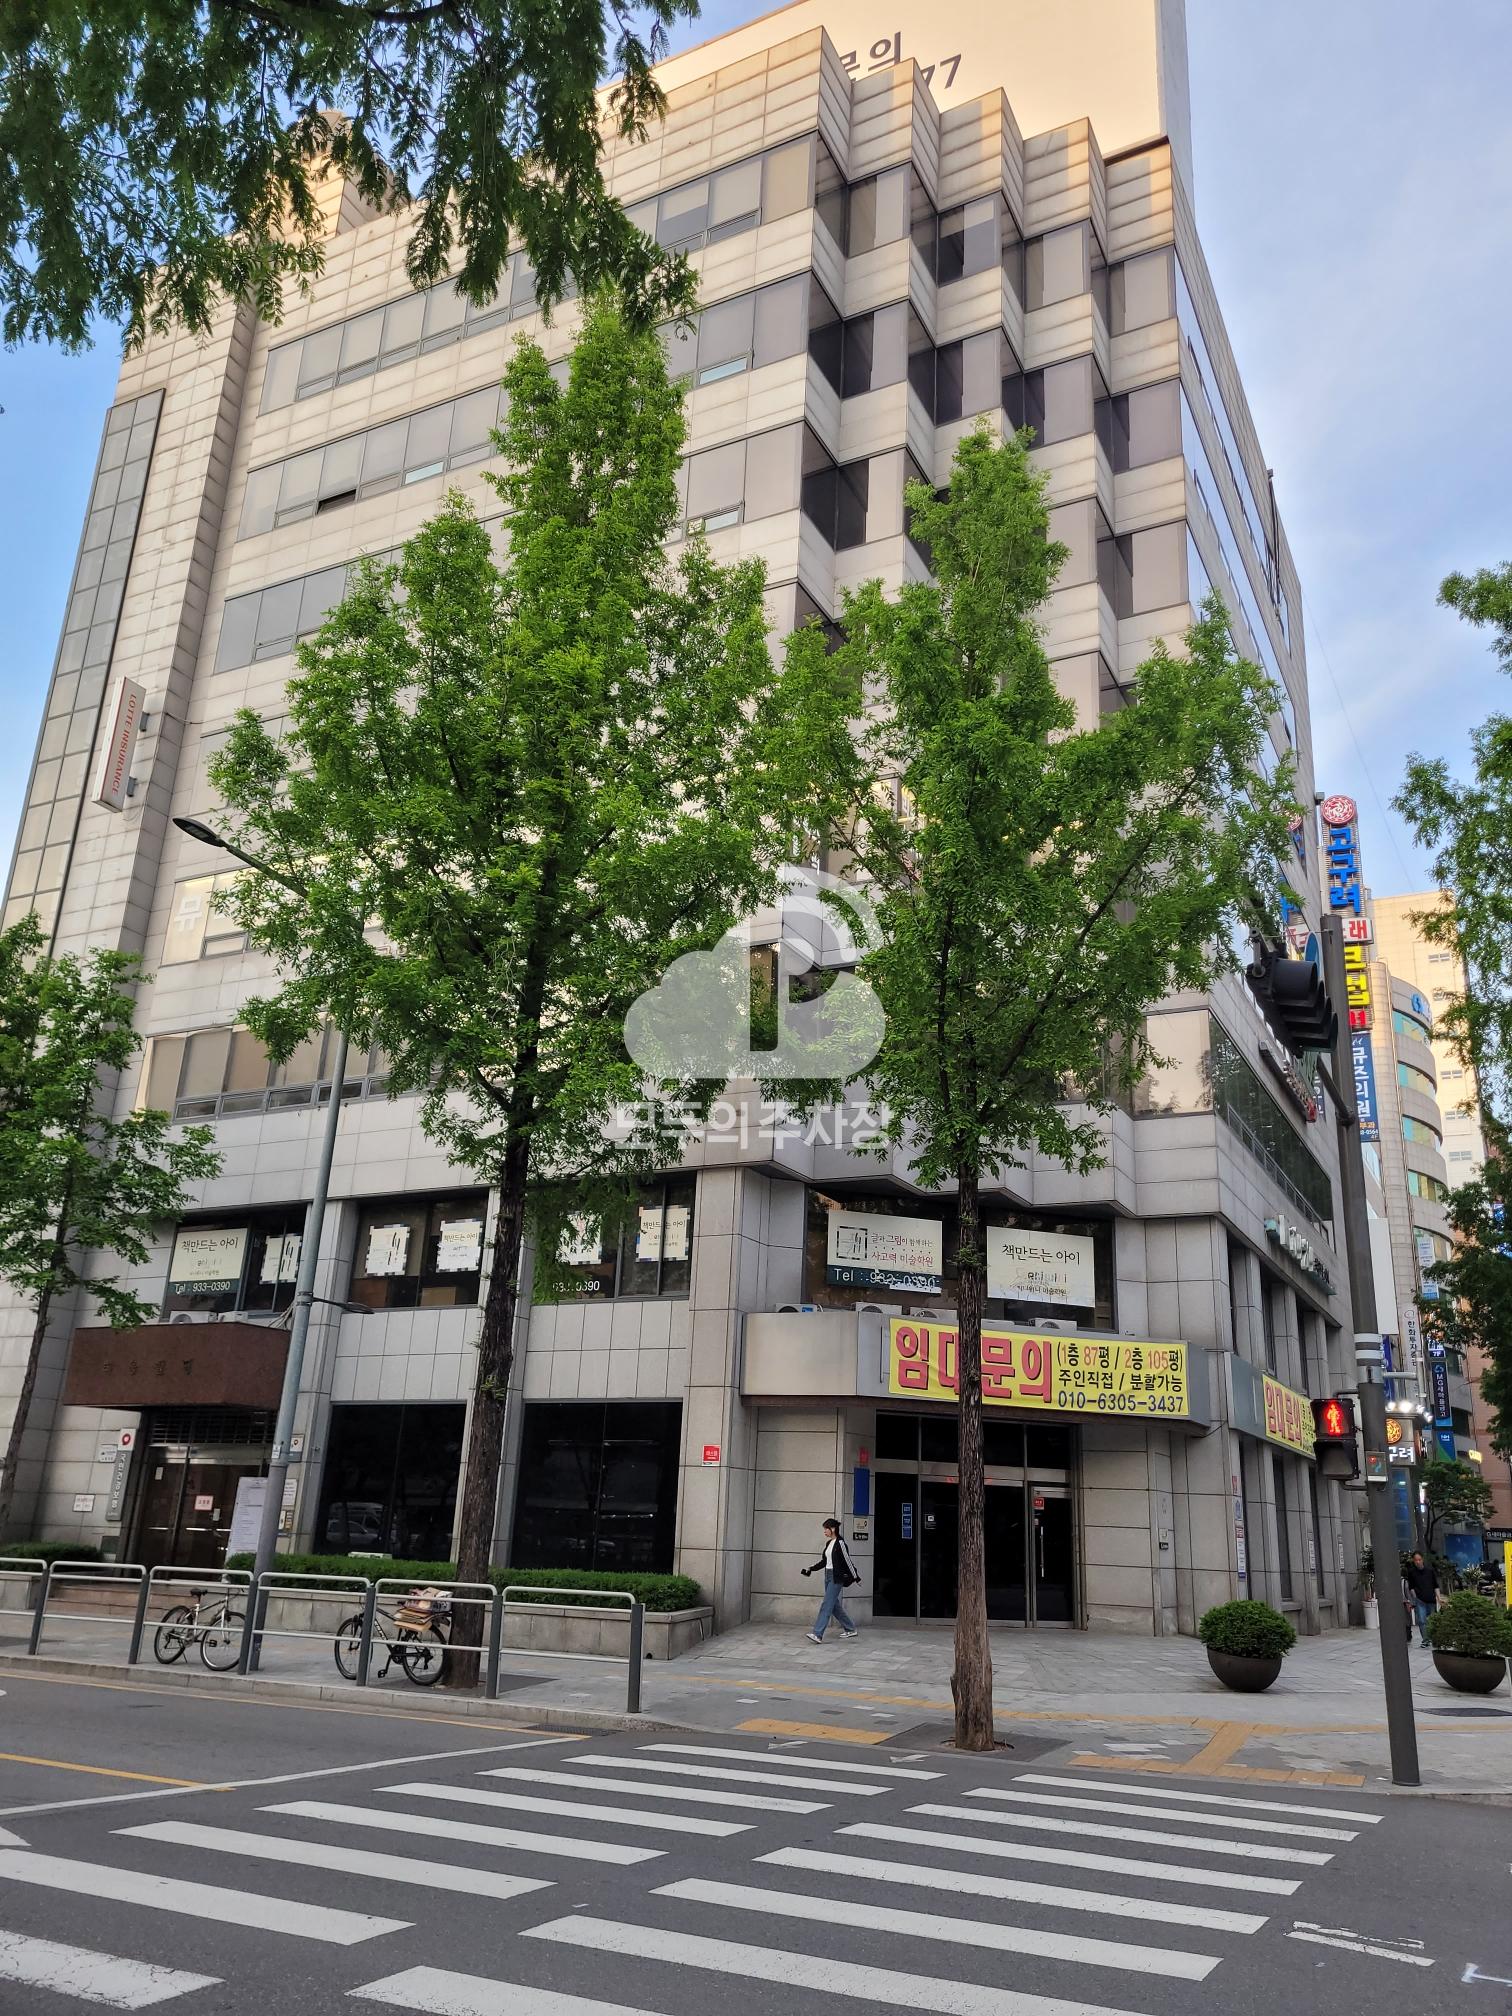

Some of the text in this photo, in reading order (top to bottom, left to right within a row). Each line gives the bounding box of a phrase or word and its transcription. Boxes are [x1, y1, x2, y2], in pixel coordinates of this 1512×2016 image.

[111, 694, 137, 796] LOTTE INSURANCE
[1327, 827, 1361, 914] 고구려
[181, 1236, 239, 1253] 책만드는 아이
[1002, 1244, 1080, 1266] 책만드는 아이
[872, 1251, 934, 1268] 사고력 미술학원
[834, 1268, 854, 1283] Tel
[192, 1281, 231, 1293] 933-0390
[895, 1325, 1053, 1404] 임대문의
[1056, 1341, 1080, 1368] (1층
[1083, 1345, 1110, 1370] 87평
[1124, 1347, 1144, 1371] 2층
[1147, 1349, 1184, 1374] 105평)
[1058, 1369, 1114, 1390] 주인직접
[1130, 1373, 1183, 1393] 분할가능
[1058, 1390, 1184, 1413] 010-6305-3437
[1264, 1380, 1302, 1447] 임대문의
[1388, 1446, 1414, 1463] 구려
